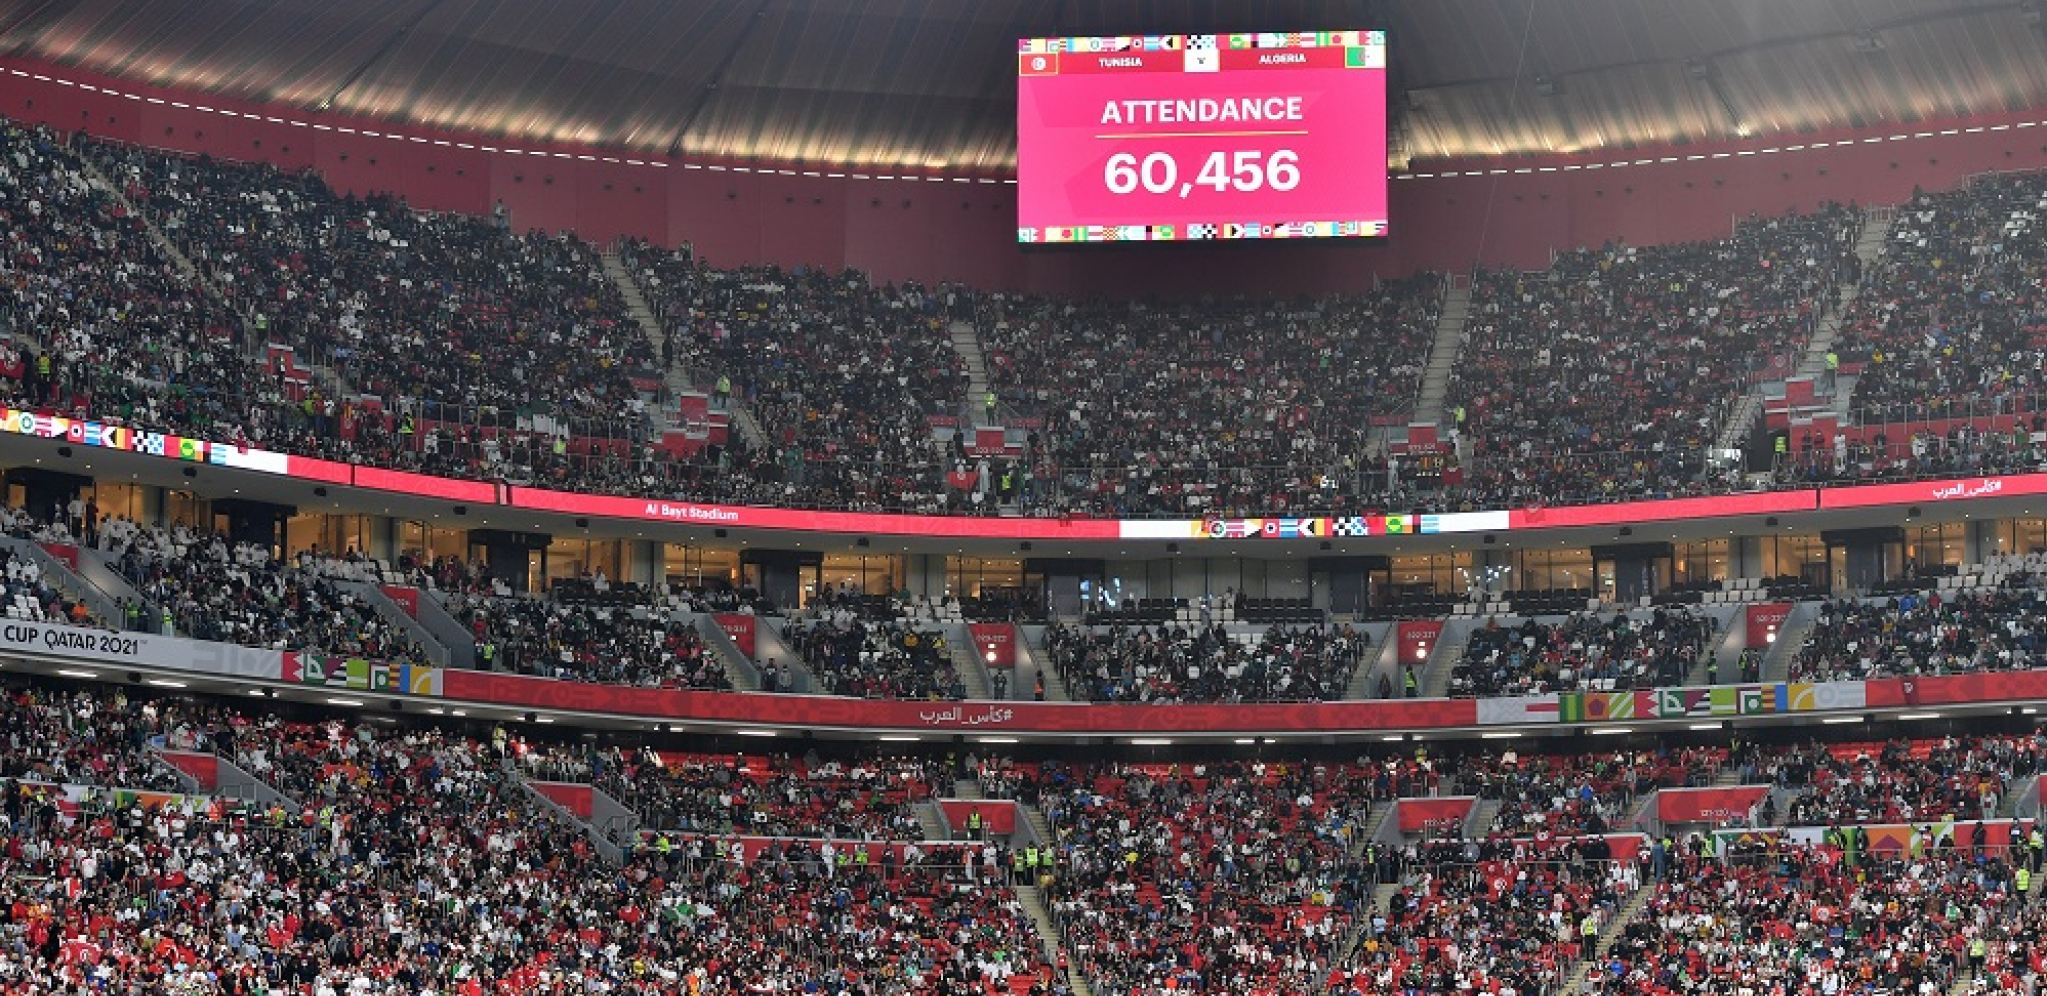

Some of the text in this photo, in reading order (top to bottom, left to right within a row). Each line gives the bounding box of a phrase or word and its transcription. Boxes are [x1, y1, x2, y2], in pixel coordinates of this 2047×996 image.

[1099, 57, 1142, 67] TUNISIA
[1259, 54, 1306, 65] ALGERIA
[1101, 97, 1303, 123] ATTENDANCE
[1104, 150, 1301, 198] 60,456
[645, 503, 738, 520] Al Bayt Stadium
[4, 625, 138, 655] CUP QATAR 2021
